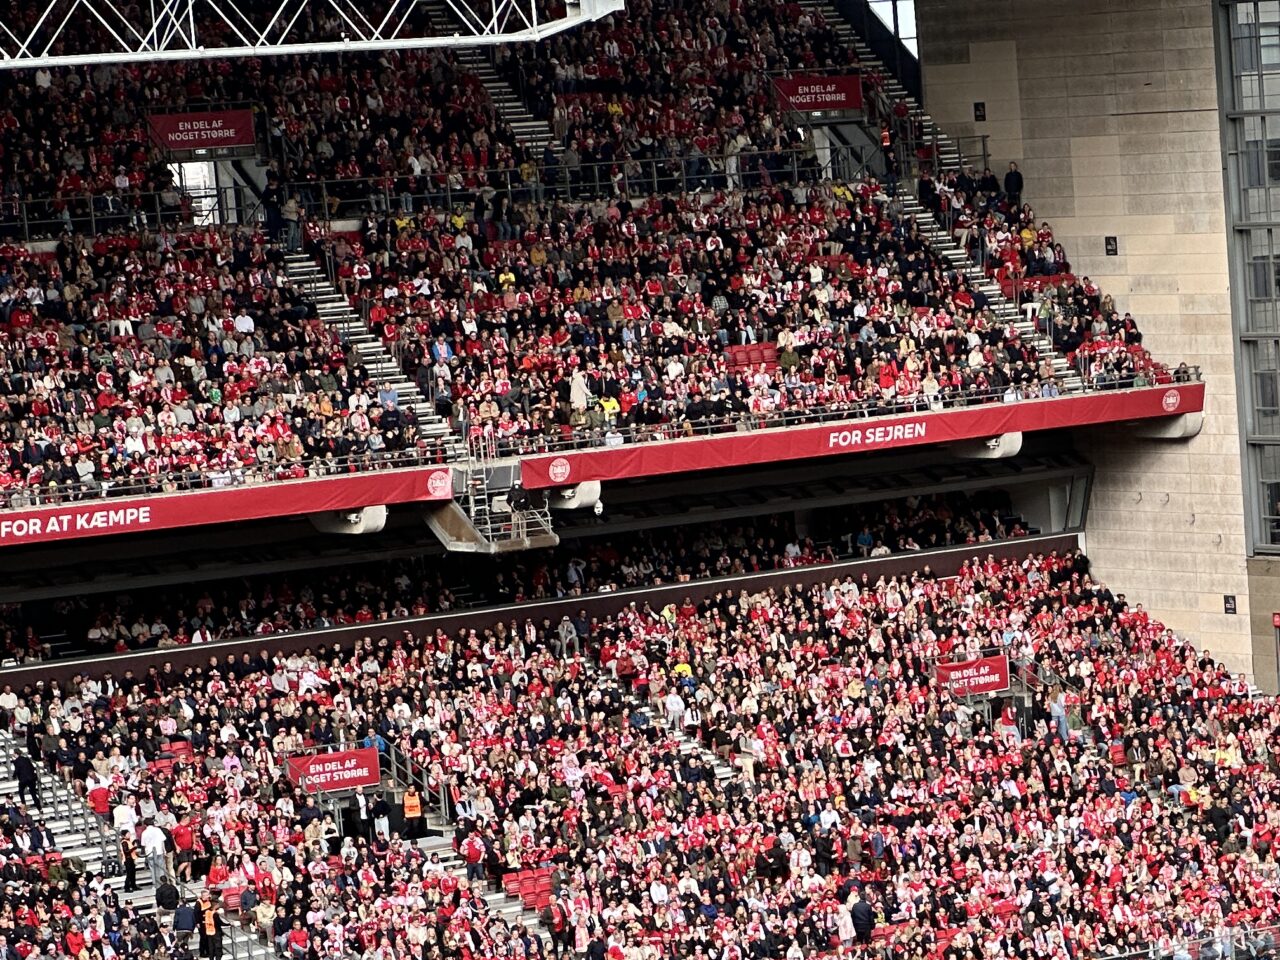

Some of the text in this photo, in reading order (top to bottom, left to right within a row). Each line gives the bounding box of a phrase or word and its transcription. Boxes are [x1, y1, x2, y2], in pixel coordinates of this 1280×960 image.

[798, 84, 837, 94] EN DEL AF
[789, 93, 847, 103] NOGET STØRRE
[178, 119, 223, 130] EN DEL AF
[168, 128, 236, 141] NOGET STØRRE
[829, 421, 927, 448] FOR SEJREN
[0, 506, 151, 538] FOR AT KÆMPE
[950, 665, 990, 680] EN DEL AF
[969, 673, 1000, 686] STØRRE
[309, 758, 357, 774] EN DEL AF
[333, 767, 369, 781] STØRRE
